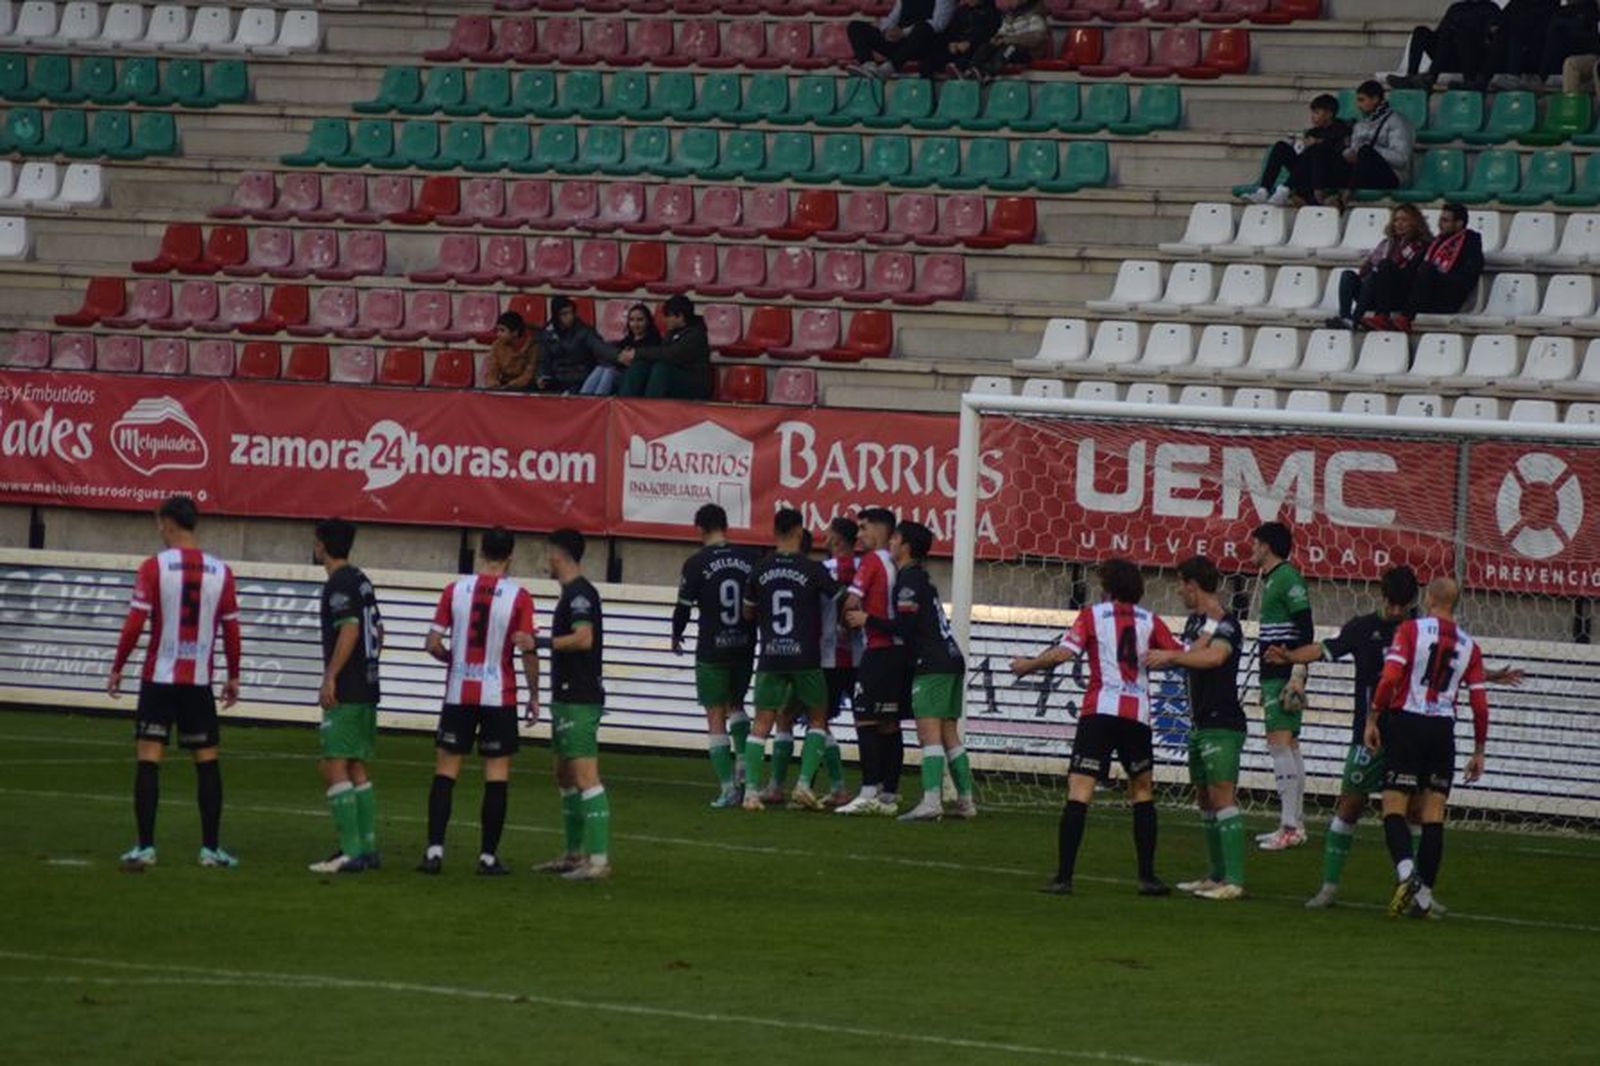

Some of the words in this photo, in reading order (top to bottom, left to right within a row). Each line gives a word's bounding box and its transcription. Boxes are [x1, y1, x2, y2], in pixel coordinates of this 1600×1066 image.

[23, 383, 96, 405] Embutidos
[0, 406, 94, 464] ades
[229, 431, 597, 484] zamora24horas.com
[650, 442, 749, 478] BARRIOS
[774, 420, 1004, 499] BARRIOS
[1075, 438, 1399, 528] UEMC
[629, 480, 713, 499] INMOBILIARIA
[1080, 531, 1390, 567] UNIVERDAD
[719, 578, 741, 626] 9
[771, 589, 794, 636] 5
[1116, 625, 1139, 668] 4
